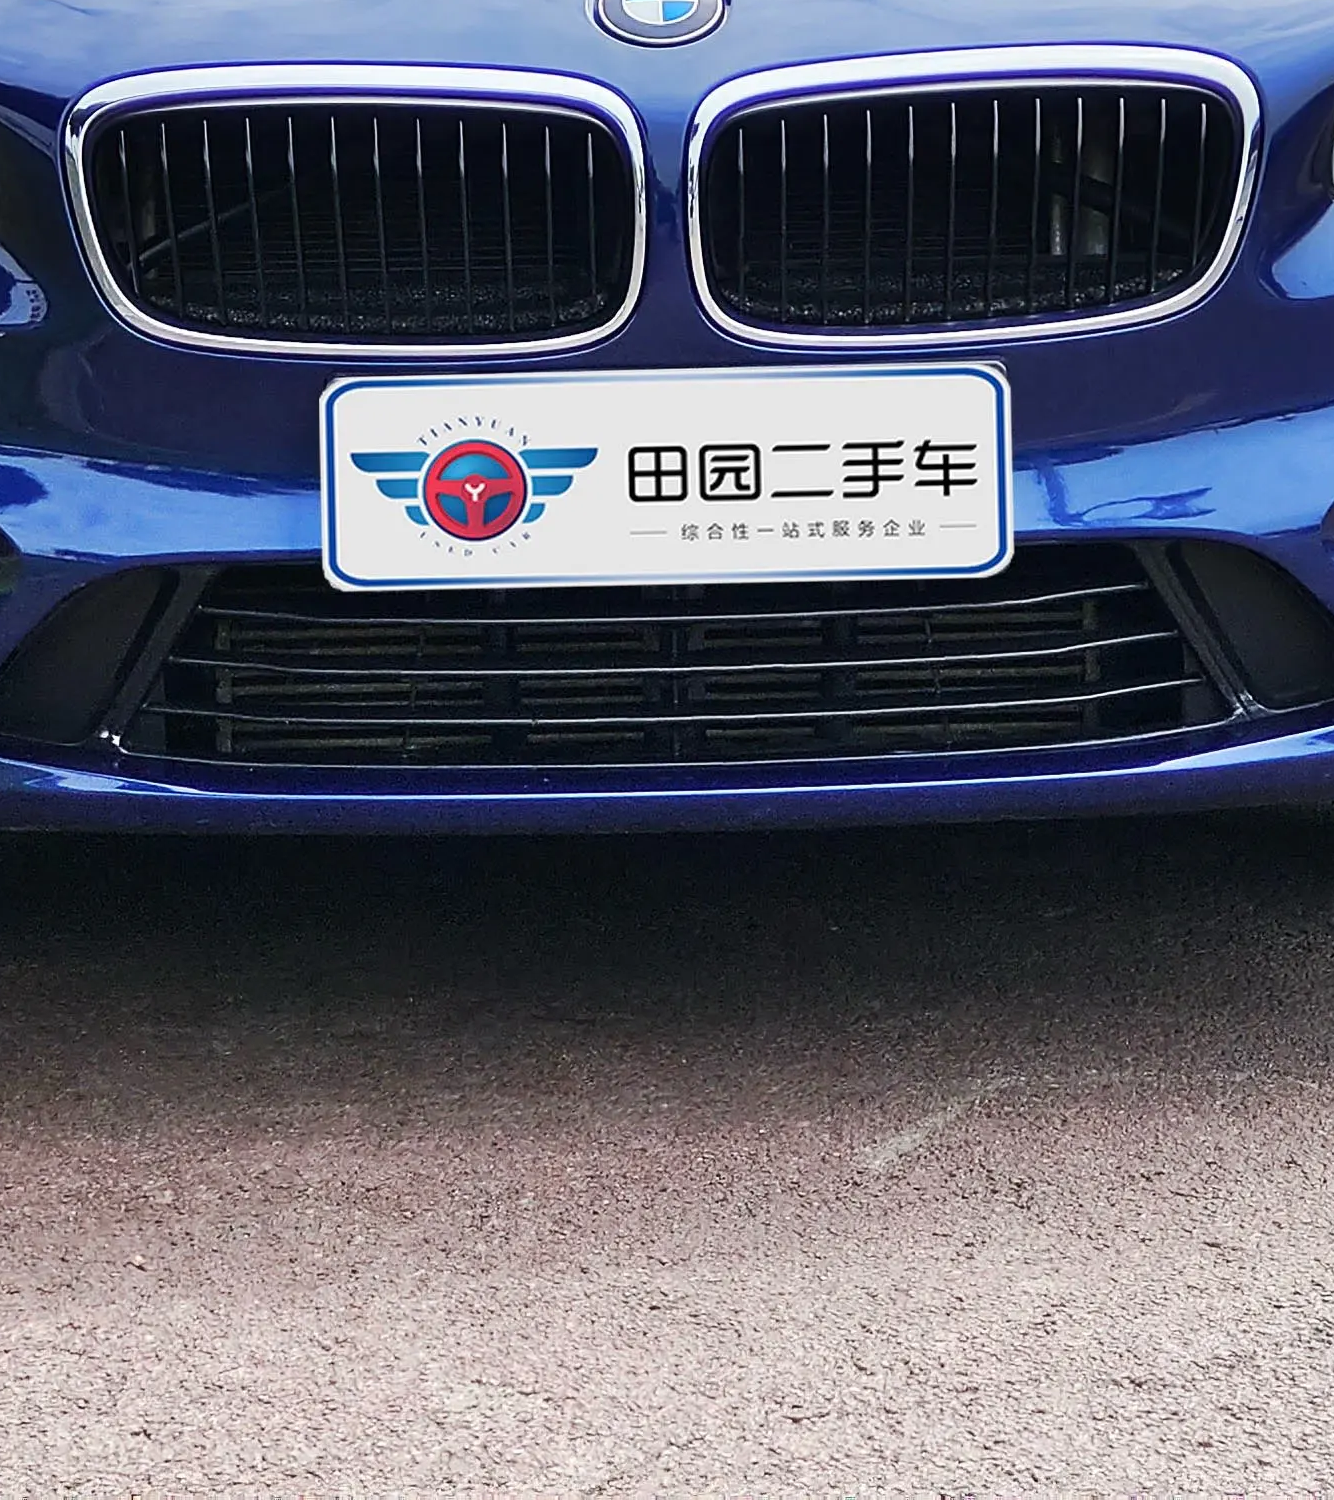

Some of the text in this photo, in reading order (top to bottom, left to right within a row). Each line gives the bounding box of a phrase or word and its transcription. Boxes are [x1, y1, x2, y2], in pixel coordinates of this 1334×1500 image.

[628, 439, 978, 503] 田园二手车
[680, 518, 926, 541] 综合性一站式服务企业
